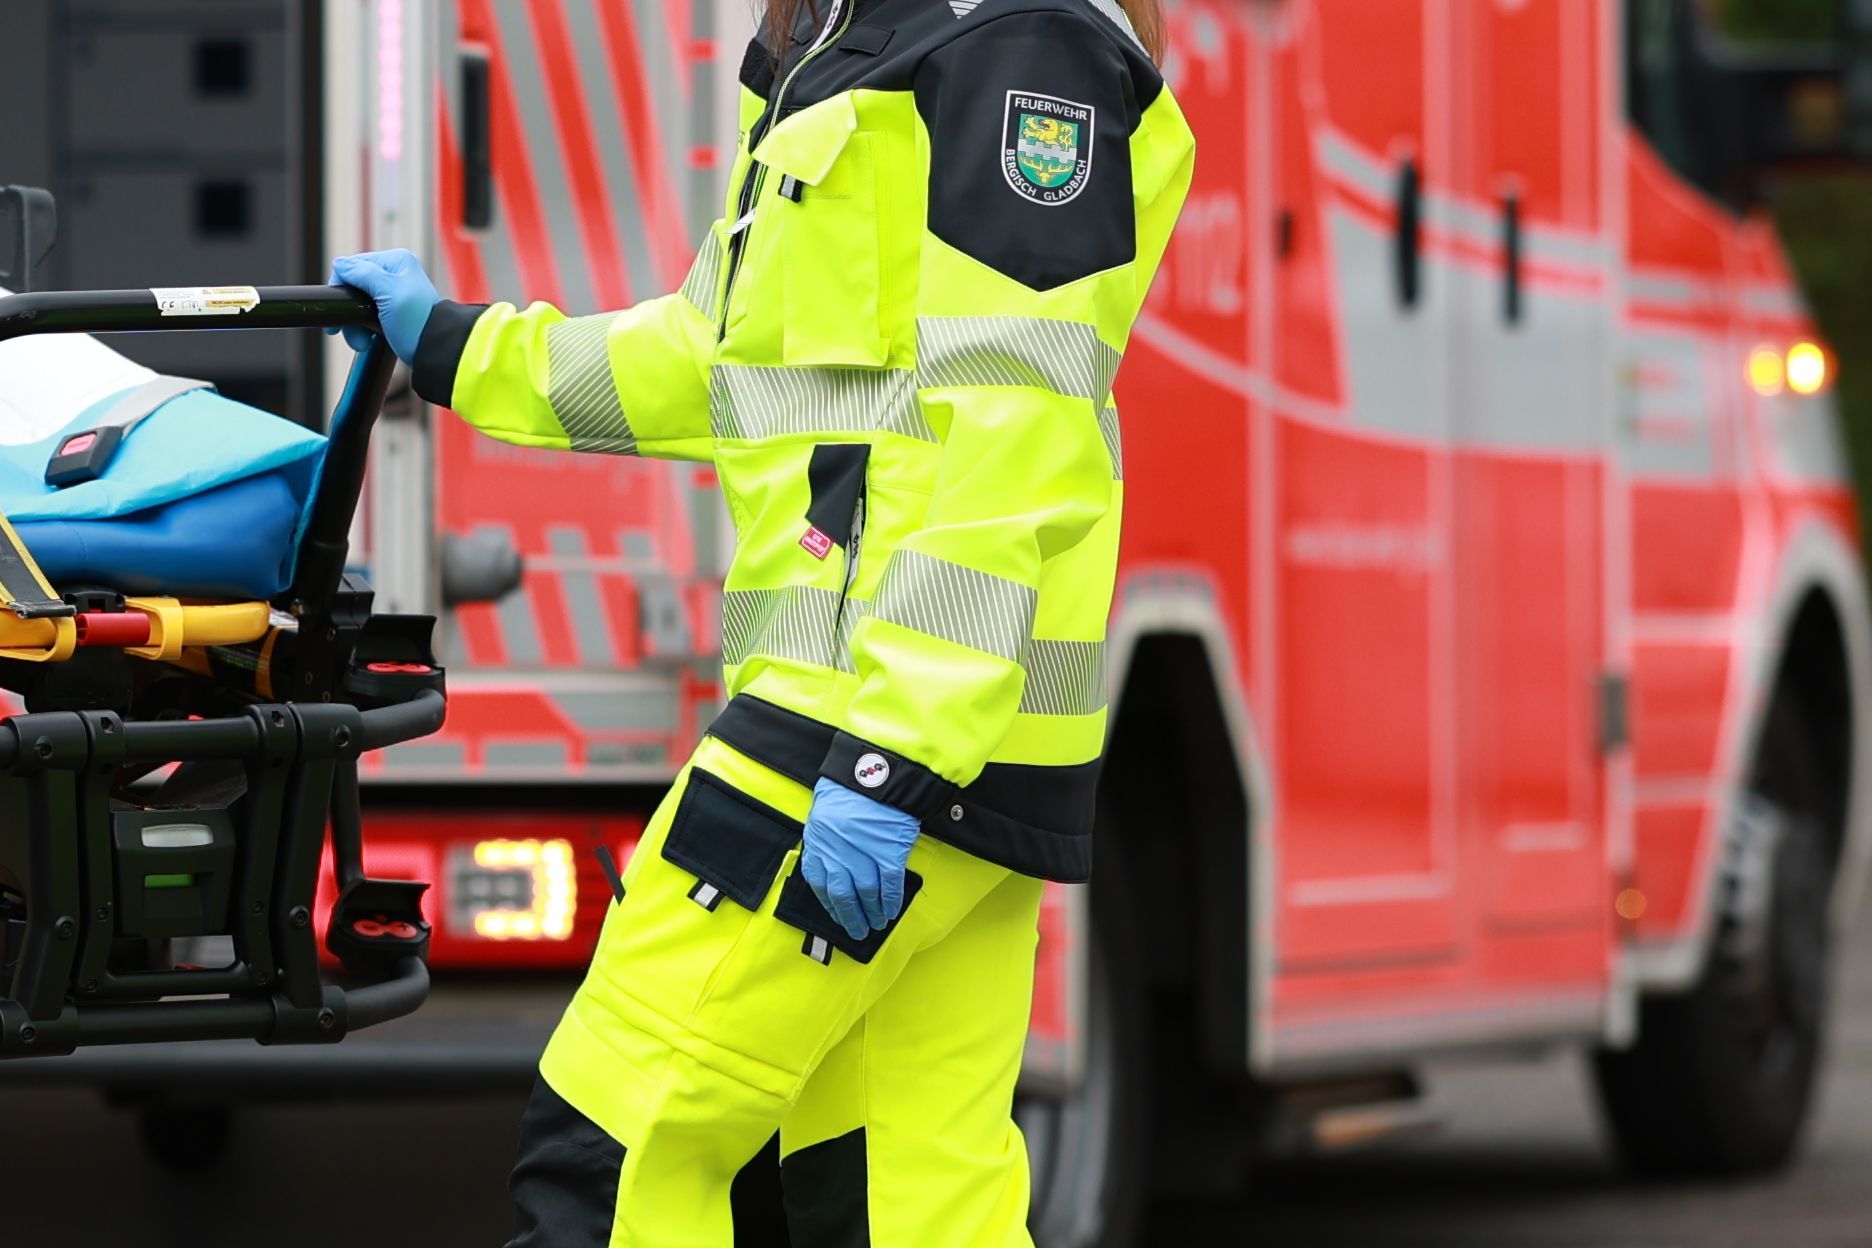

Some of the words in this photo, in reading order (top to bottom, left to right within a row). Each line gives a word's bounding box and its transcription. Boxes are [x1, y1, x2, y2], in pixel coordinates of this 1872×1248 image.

[1014, 96, 1088, 121] FEUERWEHR
[1005, 148, 1037, 197] BERGISCH
[1043, 159, 1087, 201] GLADBACH
